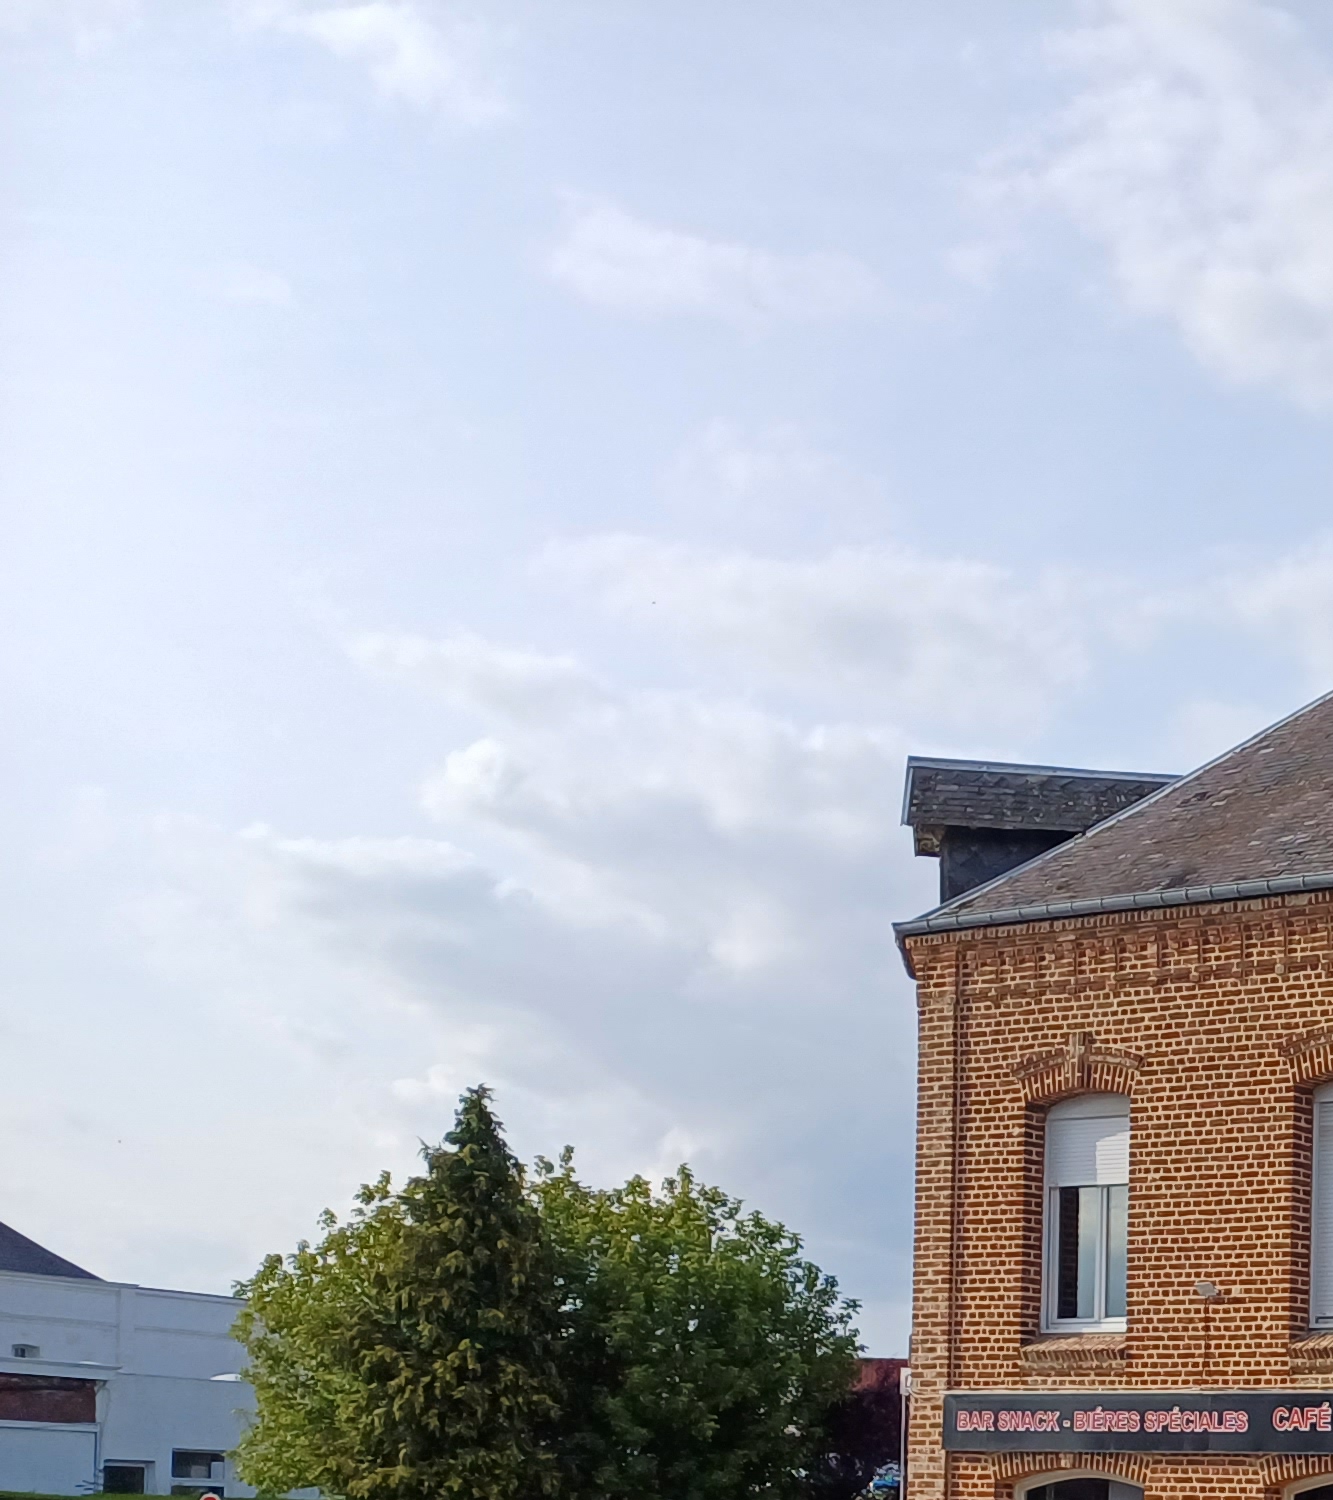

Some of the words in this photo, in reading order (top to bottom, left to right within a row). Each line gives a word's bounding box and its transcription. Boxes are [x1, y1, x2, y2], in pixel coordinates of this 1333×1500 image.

[957, 1411, 994, 1431] BAR
[997, 1411, 1060, 1432] SNACK
[1144, 1406, 1248, 1432] SPÉCIALES
[1272, 1402, 1332, 1431] CAFÉ
